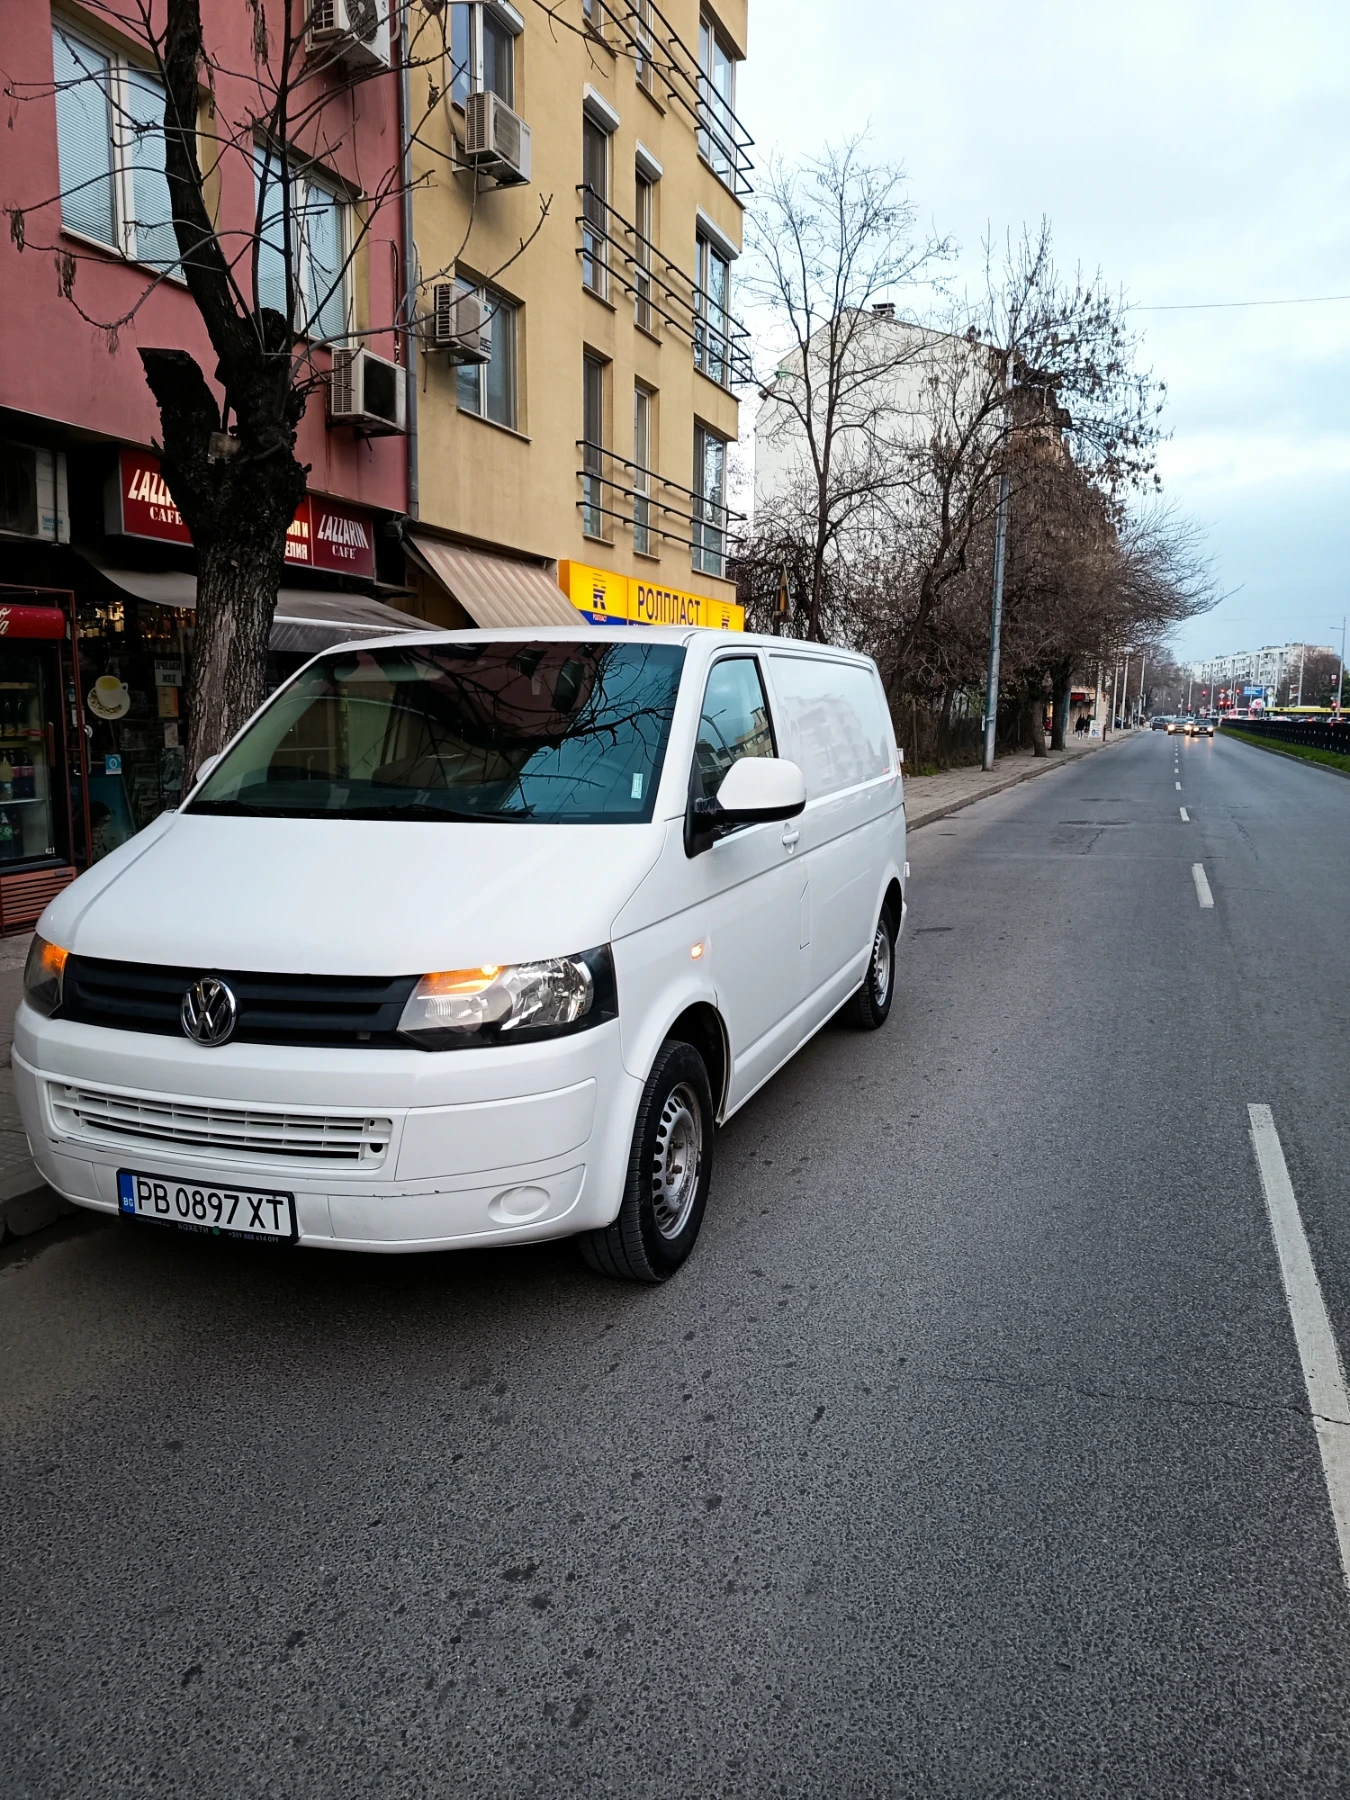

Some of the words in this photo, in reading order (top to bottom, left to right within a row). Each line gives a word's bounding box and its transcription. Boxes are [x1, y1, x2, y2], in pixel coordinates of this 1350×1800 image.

[127, 469, 177, 508] LAZZA
[284, 540, 308, 560] ЕЛИЯ
[317, 514, 370, 550] LAZZARIN
[637, 585, 701, 626] РОЛПЛАСТ
[123, 1196, 134, 1207] BG
[136, 1180, 170, 1214] PB
[175, 1187, 240, 1225] 0897
[246, 1196, 284, 1231] XT
